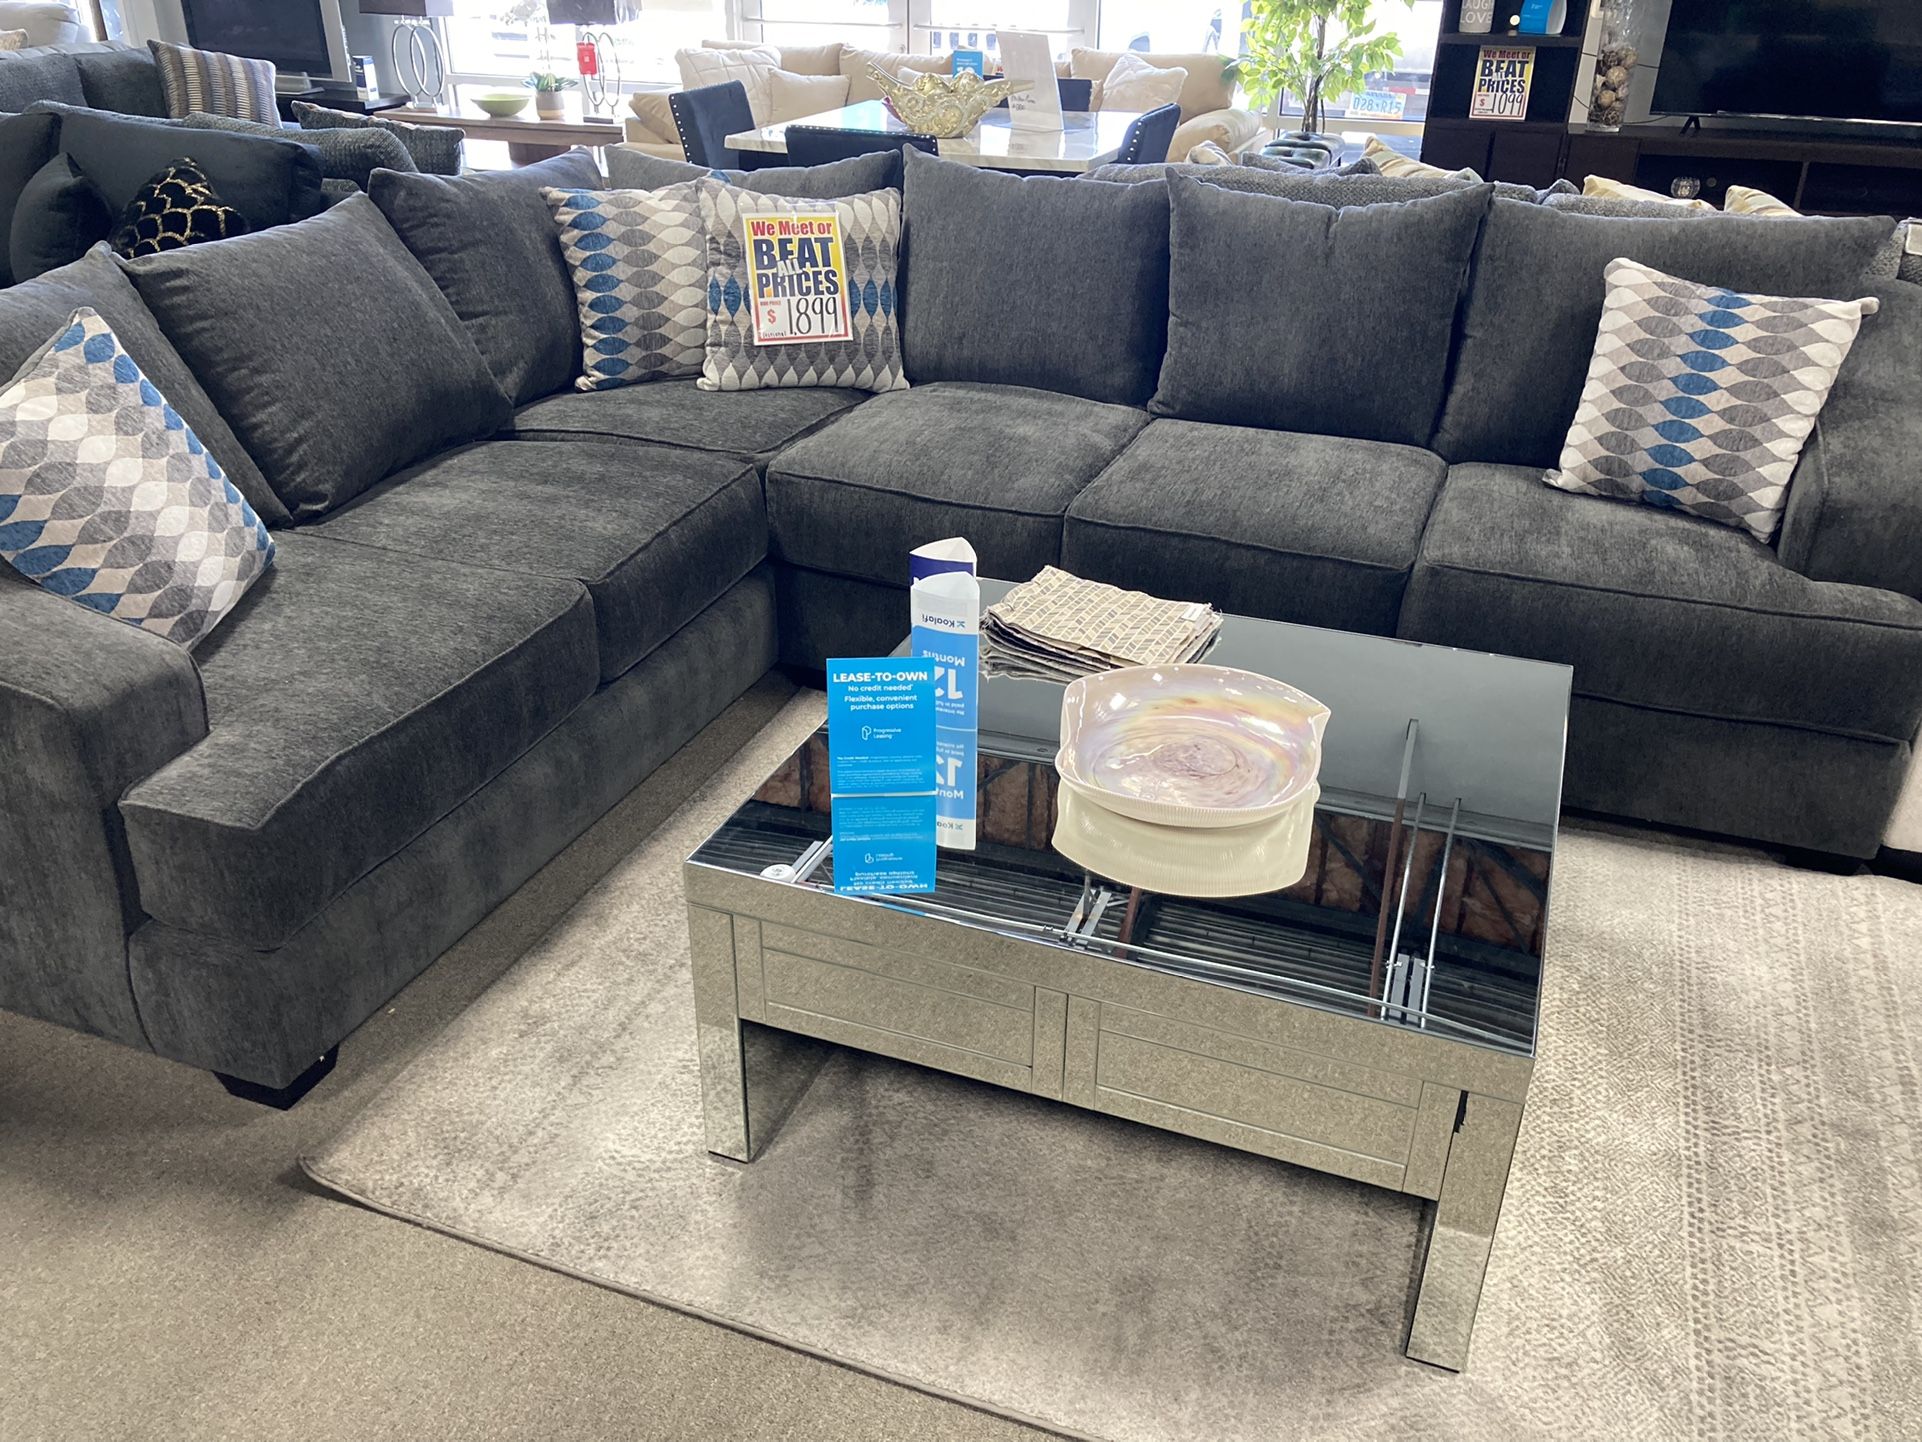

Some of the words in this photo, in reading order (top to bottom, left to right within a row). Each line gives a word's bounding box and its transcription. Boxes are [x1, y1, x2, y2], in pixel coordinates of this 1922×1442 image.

[1483, 49, 1497, 59] We
[1498, 50, 1520, 59] Meet
[1521, 51, 1531, 60] or
[1480, 59, 1529, 78] BEAT
[1478, 78, 1526, 94] PRICES
[750, 220, 775, 236] We
[778, 220, 814, 235] Meet
[818, 222, 832, 235] or
[753, 237, 834, 270] BEAT
[776, 257, 803, 278] ALL
[756, 270, 840, 299] PRICES
[767, 309, 777, 324] $
[921, 613, 956, 628] Koalafi
[832, 671, 929, 683] LEASE-TO-OWN
[860, 684, 882, 692] credit
[844, 695, 875, 703] Flexible,
[850, 703, 885, 712] purchase
[886, 702, 914, 711] options
